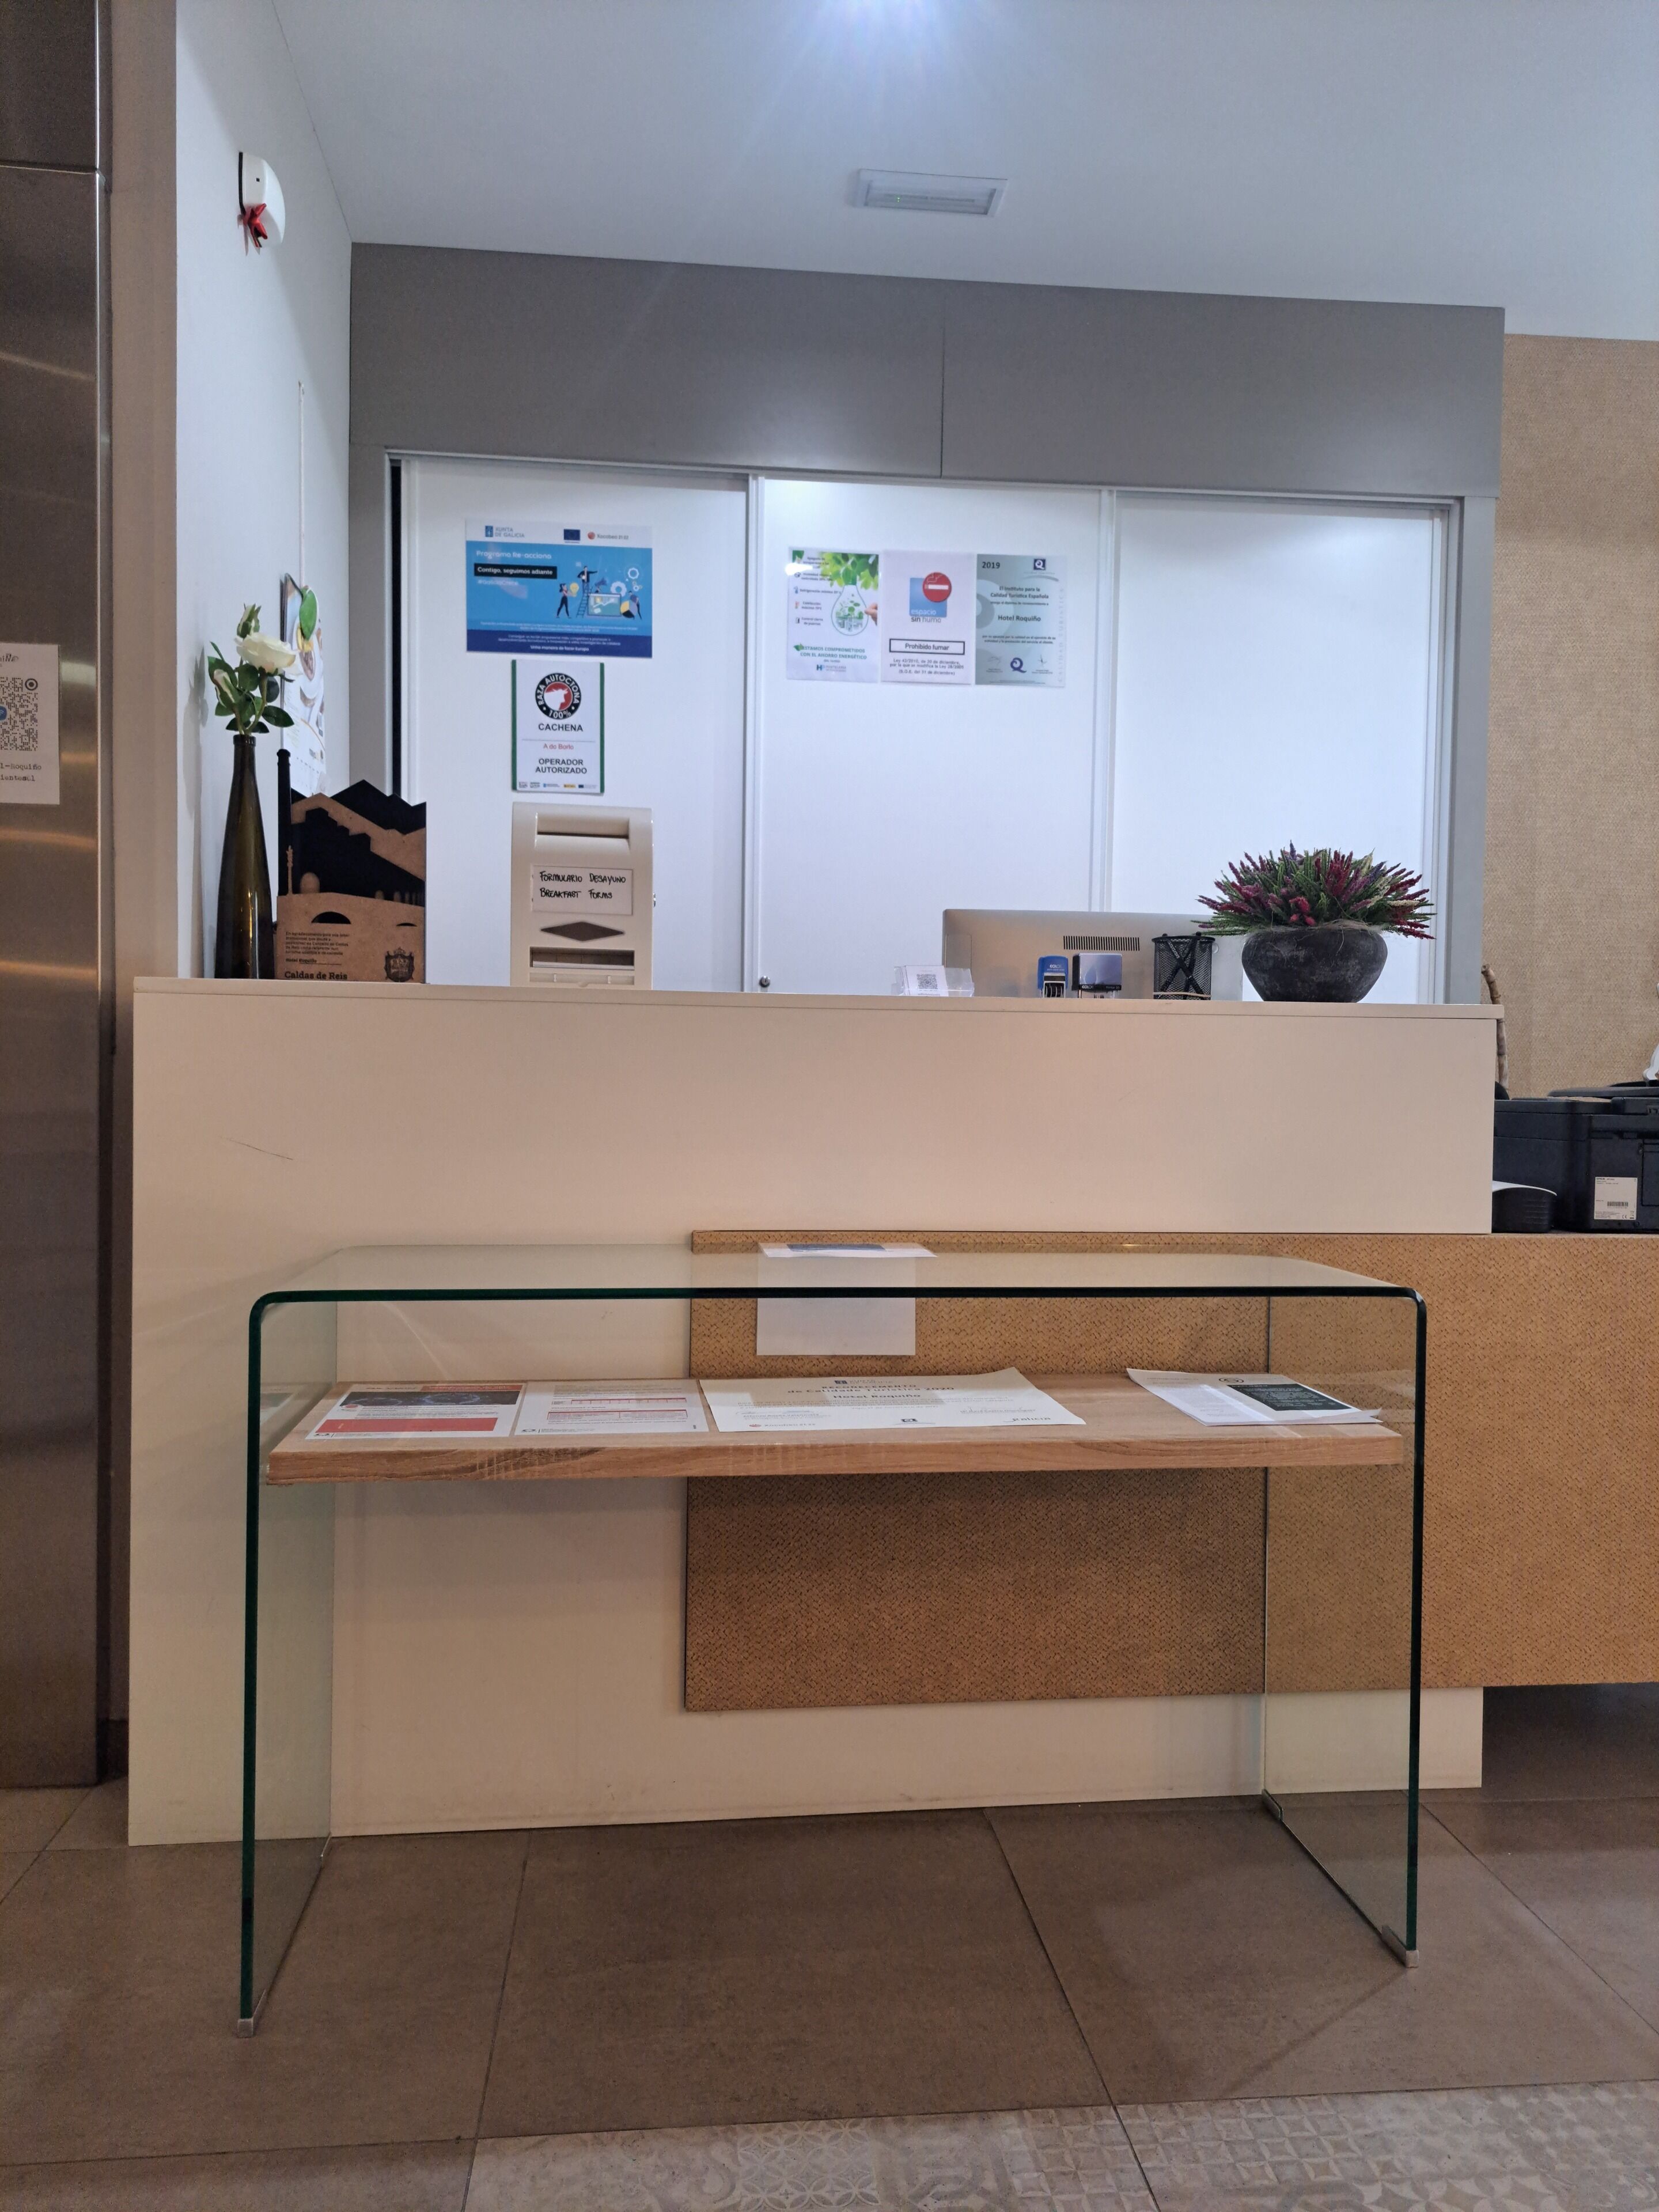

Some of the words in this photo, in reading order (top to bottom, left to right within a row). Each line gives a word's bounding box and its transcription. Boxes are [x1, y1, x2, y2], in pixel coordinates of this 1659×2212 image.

[982, 561, 1000, 569] 2019
[537, 684, 546, 705] RAZA
[549, 710, 571, 718] 100%
[538, 723, 584, 732] CACHENA
[536, 766, 587, 774] AUTORIZADO
[540, 870, 582, 883] FORMULARIO
[589, 873, 626, 885] DESAYUNO
[540, 887, 581, 899] BREAKFAST
[588, 889, 613, 899] FORMS
[285, 971, 314, 979] Caldas
[329, 972, 347, 980] Reis
